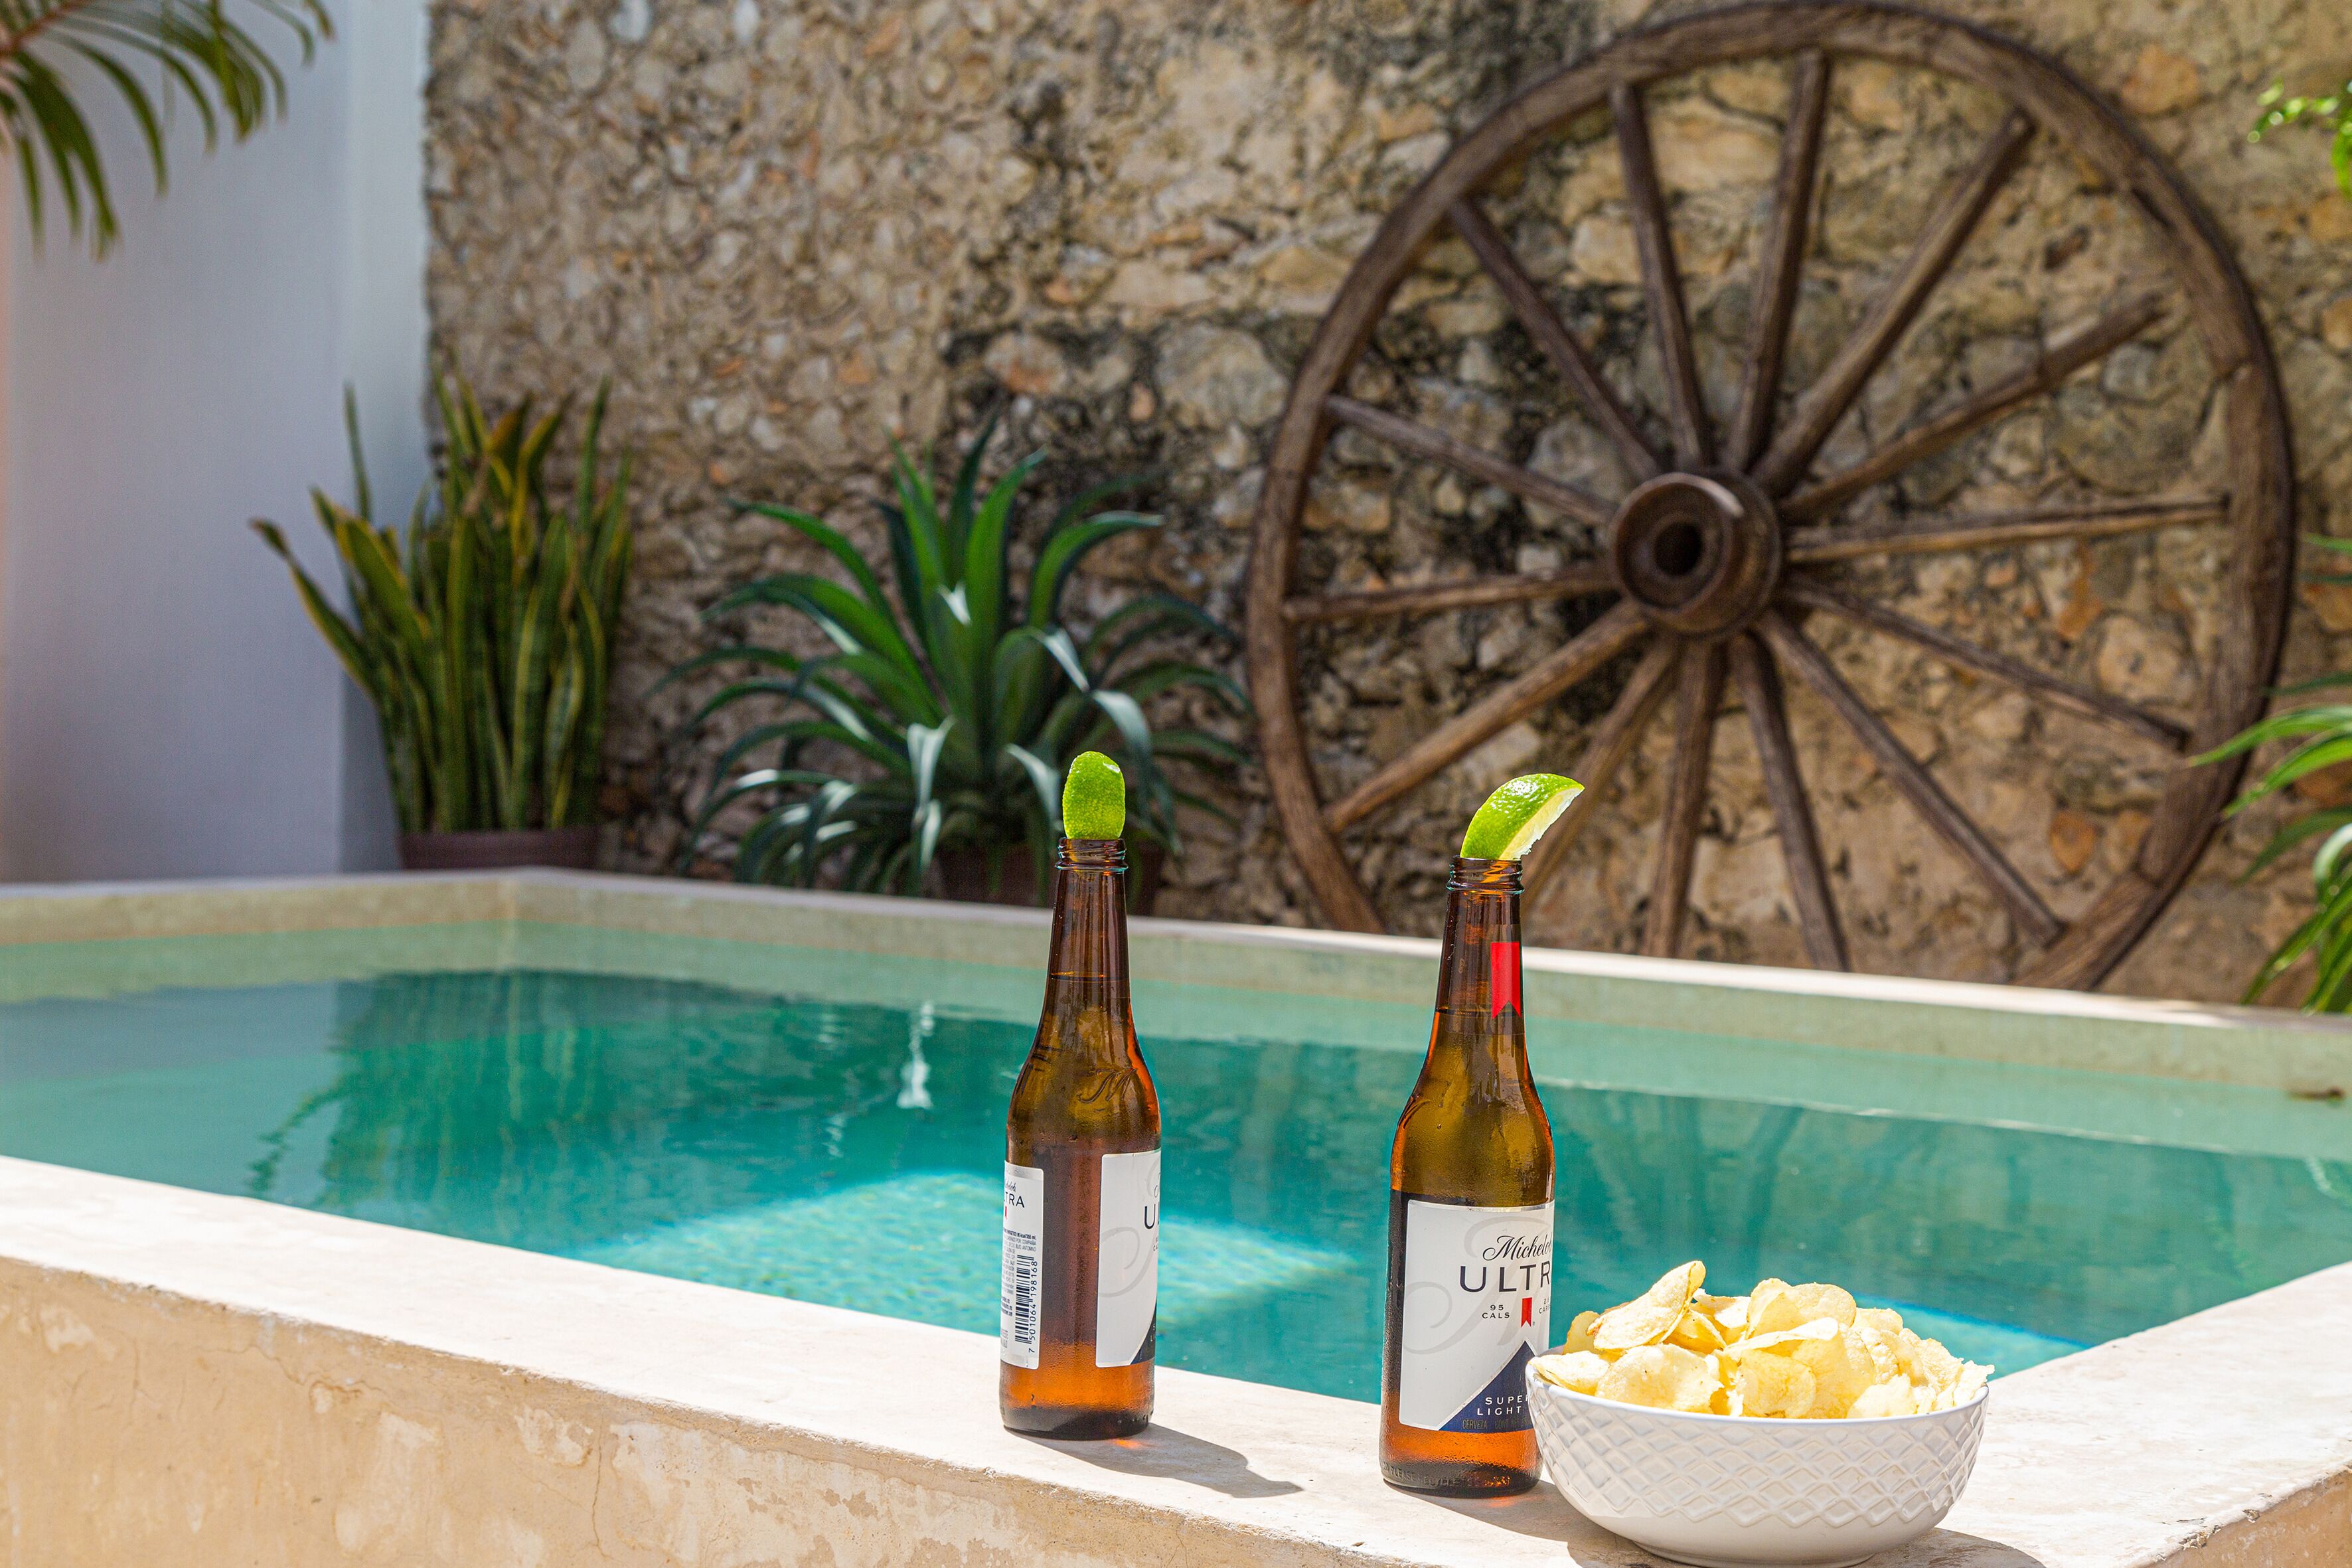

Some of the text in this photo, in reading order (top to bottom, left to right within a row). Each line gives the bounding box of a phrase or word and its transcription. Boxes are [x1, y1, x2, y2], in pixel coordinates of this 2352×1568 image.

[1004, 1191, 1025, 1208] TRA
[1460, 1260, 1551, 1293] ULTR
[1477, 1406, 1522, 1416] LIGHT
[1462, 1419, 1488, 1429] CERVEZA
